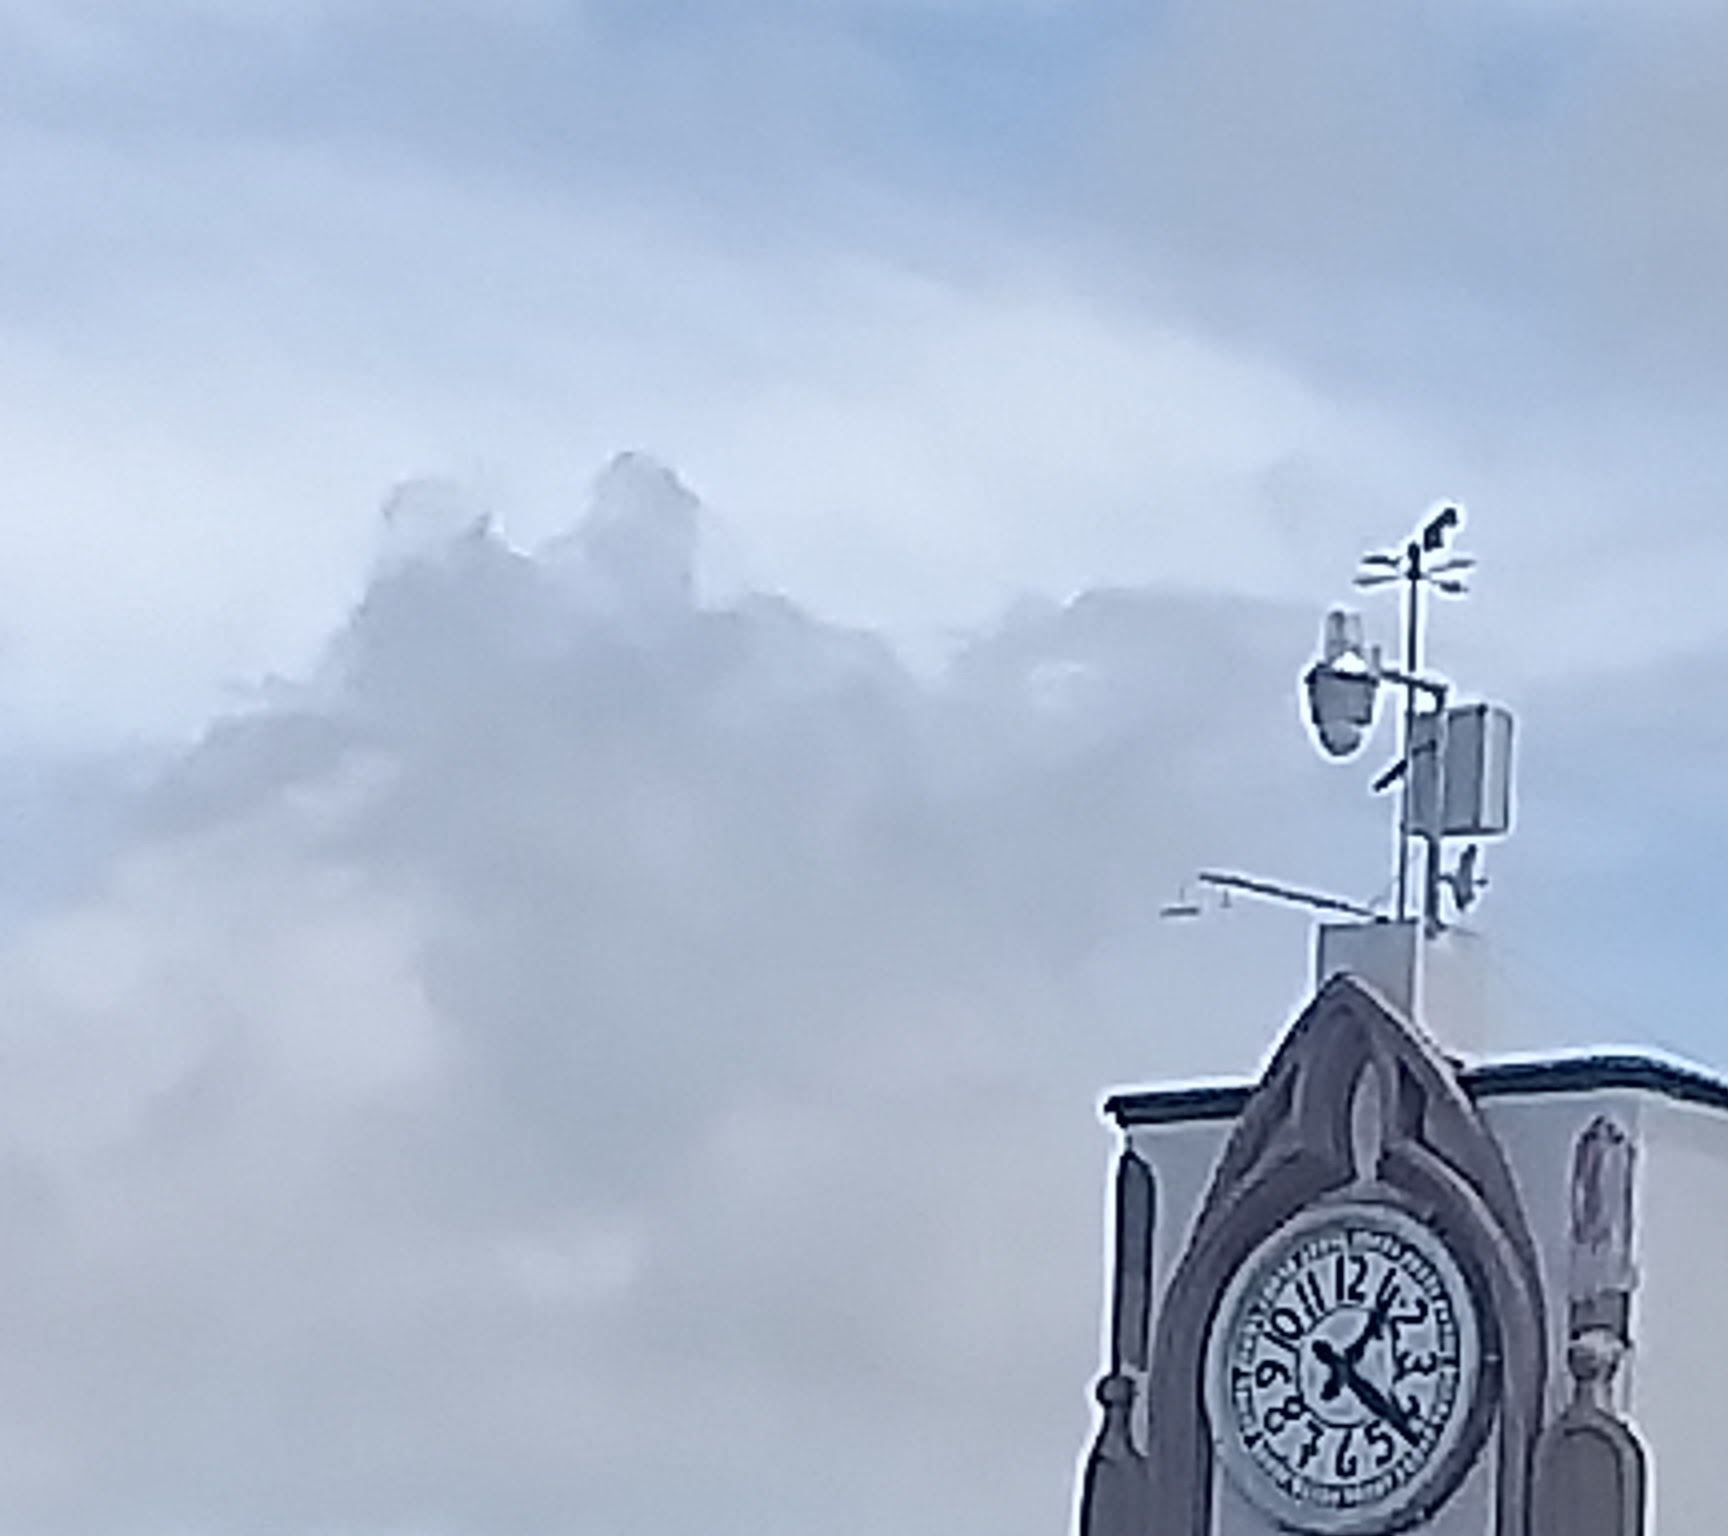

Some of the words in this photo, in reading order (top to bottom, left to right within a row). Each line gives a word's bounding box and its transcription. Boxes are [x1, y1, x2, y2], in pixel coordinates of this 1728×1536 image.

[1295, 1271, 1326, 1321] 11
[1336, 1255, 1369, 1302] 12
[1262, 1307, 1304, 1352] 10
[1391, 1300, 1429, 1342] 2
[1255, 1359, 1293, 1389] 9
[1397, 1351, 1438, 1379] 3
[1264, 1396, 1309, 1435] 8
[1299, 1419, 1325, 1468] 7
[1335, 1428, 1358, 1478] 6
[1364, 1420, 1395, 1467] 5
